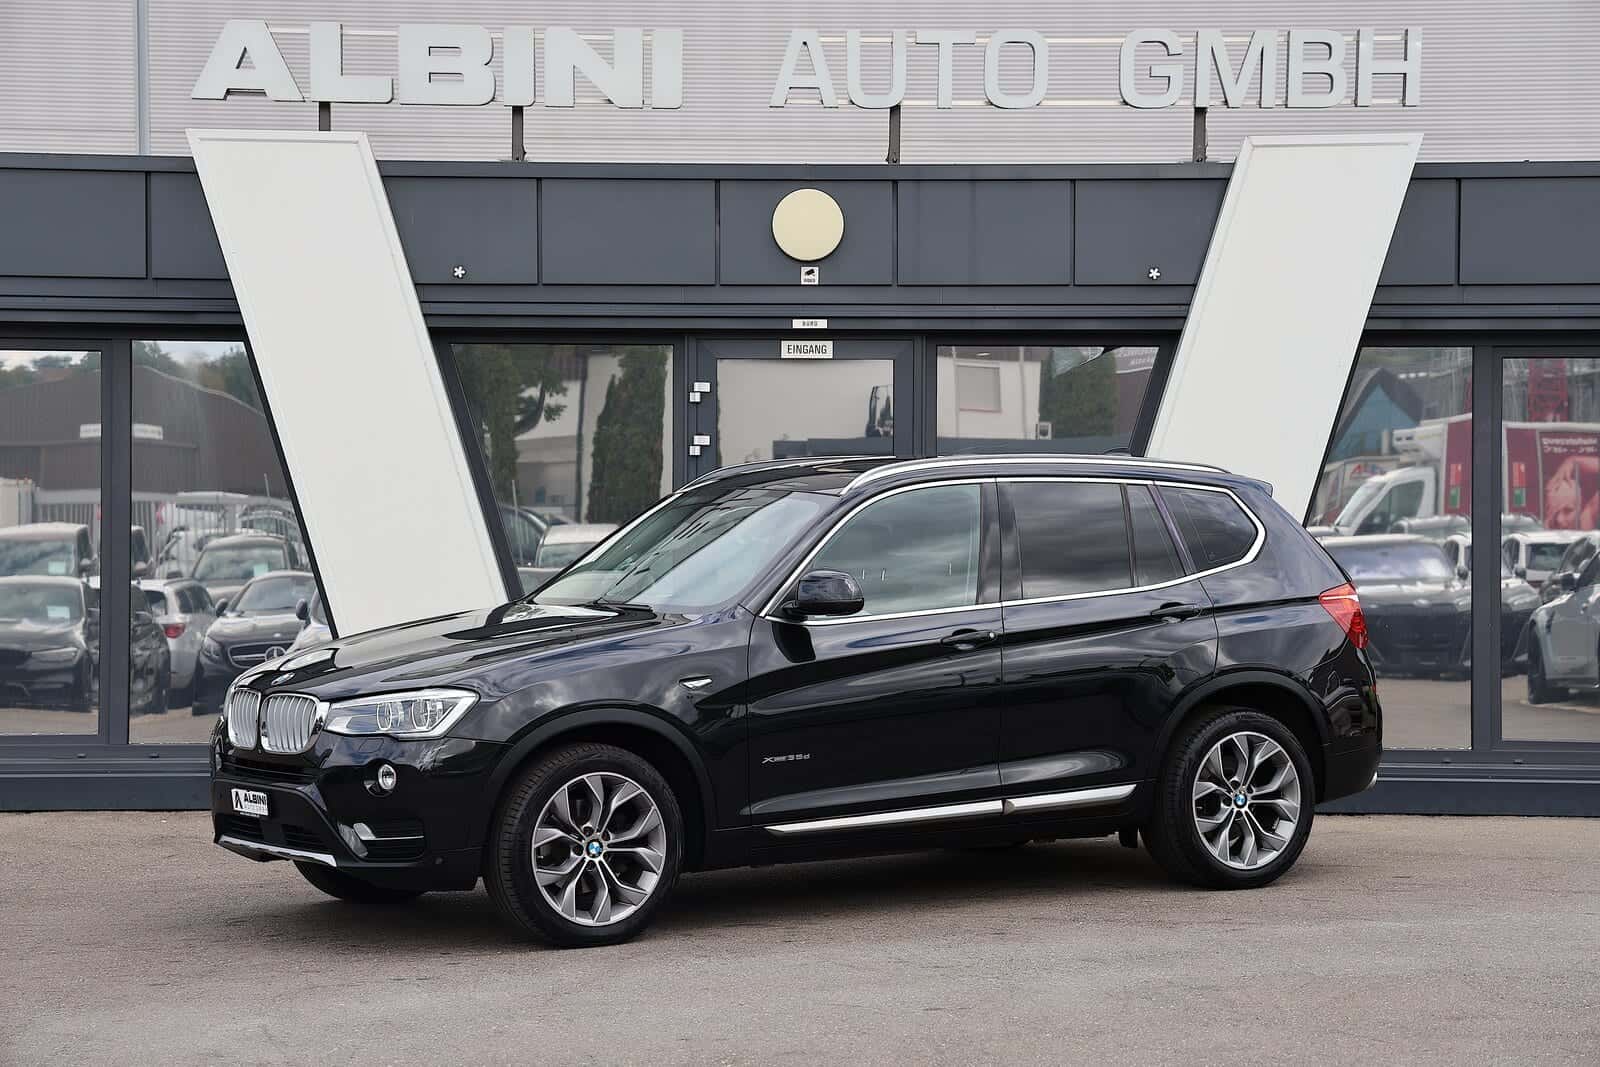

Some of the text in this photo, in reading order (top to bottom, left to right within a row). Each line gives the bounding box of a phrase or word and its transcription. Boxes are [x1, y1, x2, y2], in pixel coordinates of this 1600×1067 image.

[192, 19, 1423, 110] ALBINI AUTO GMBH
[787, 344, 827, 354] EINGANG
